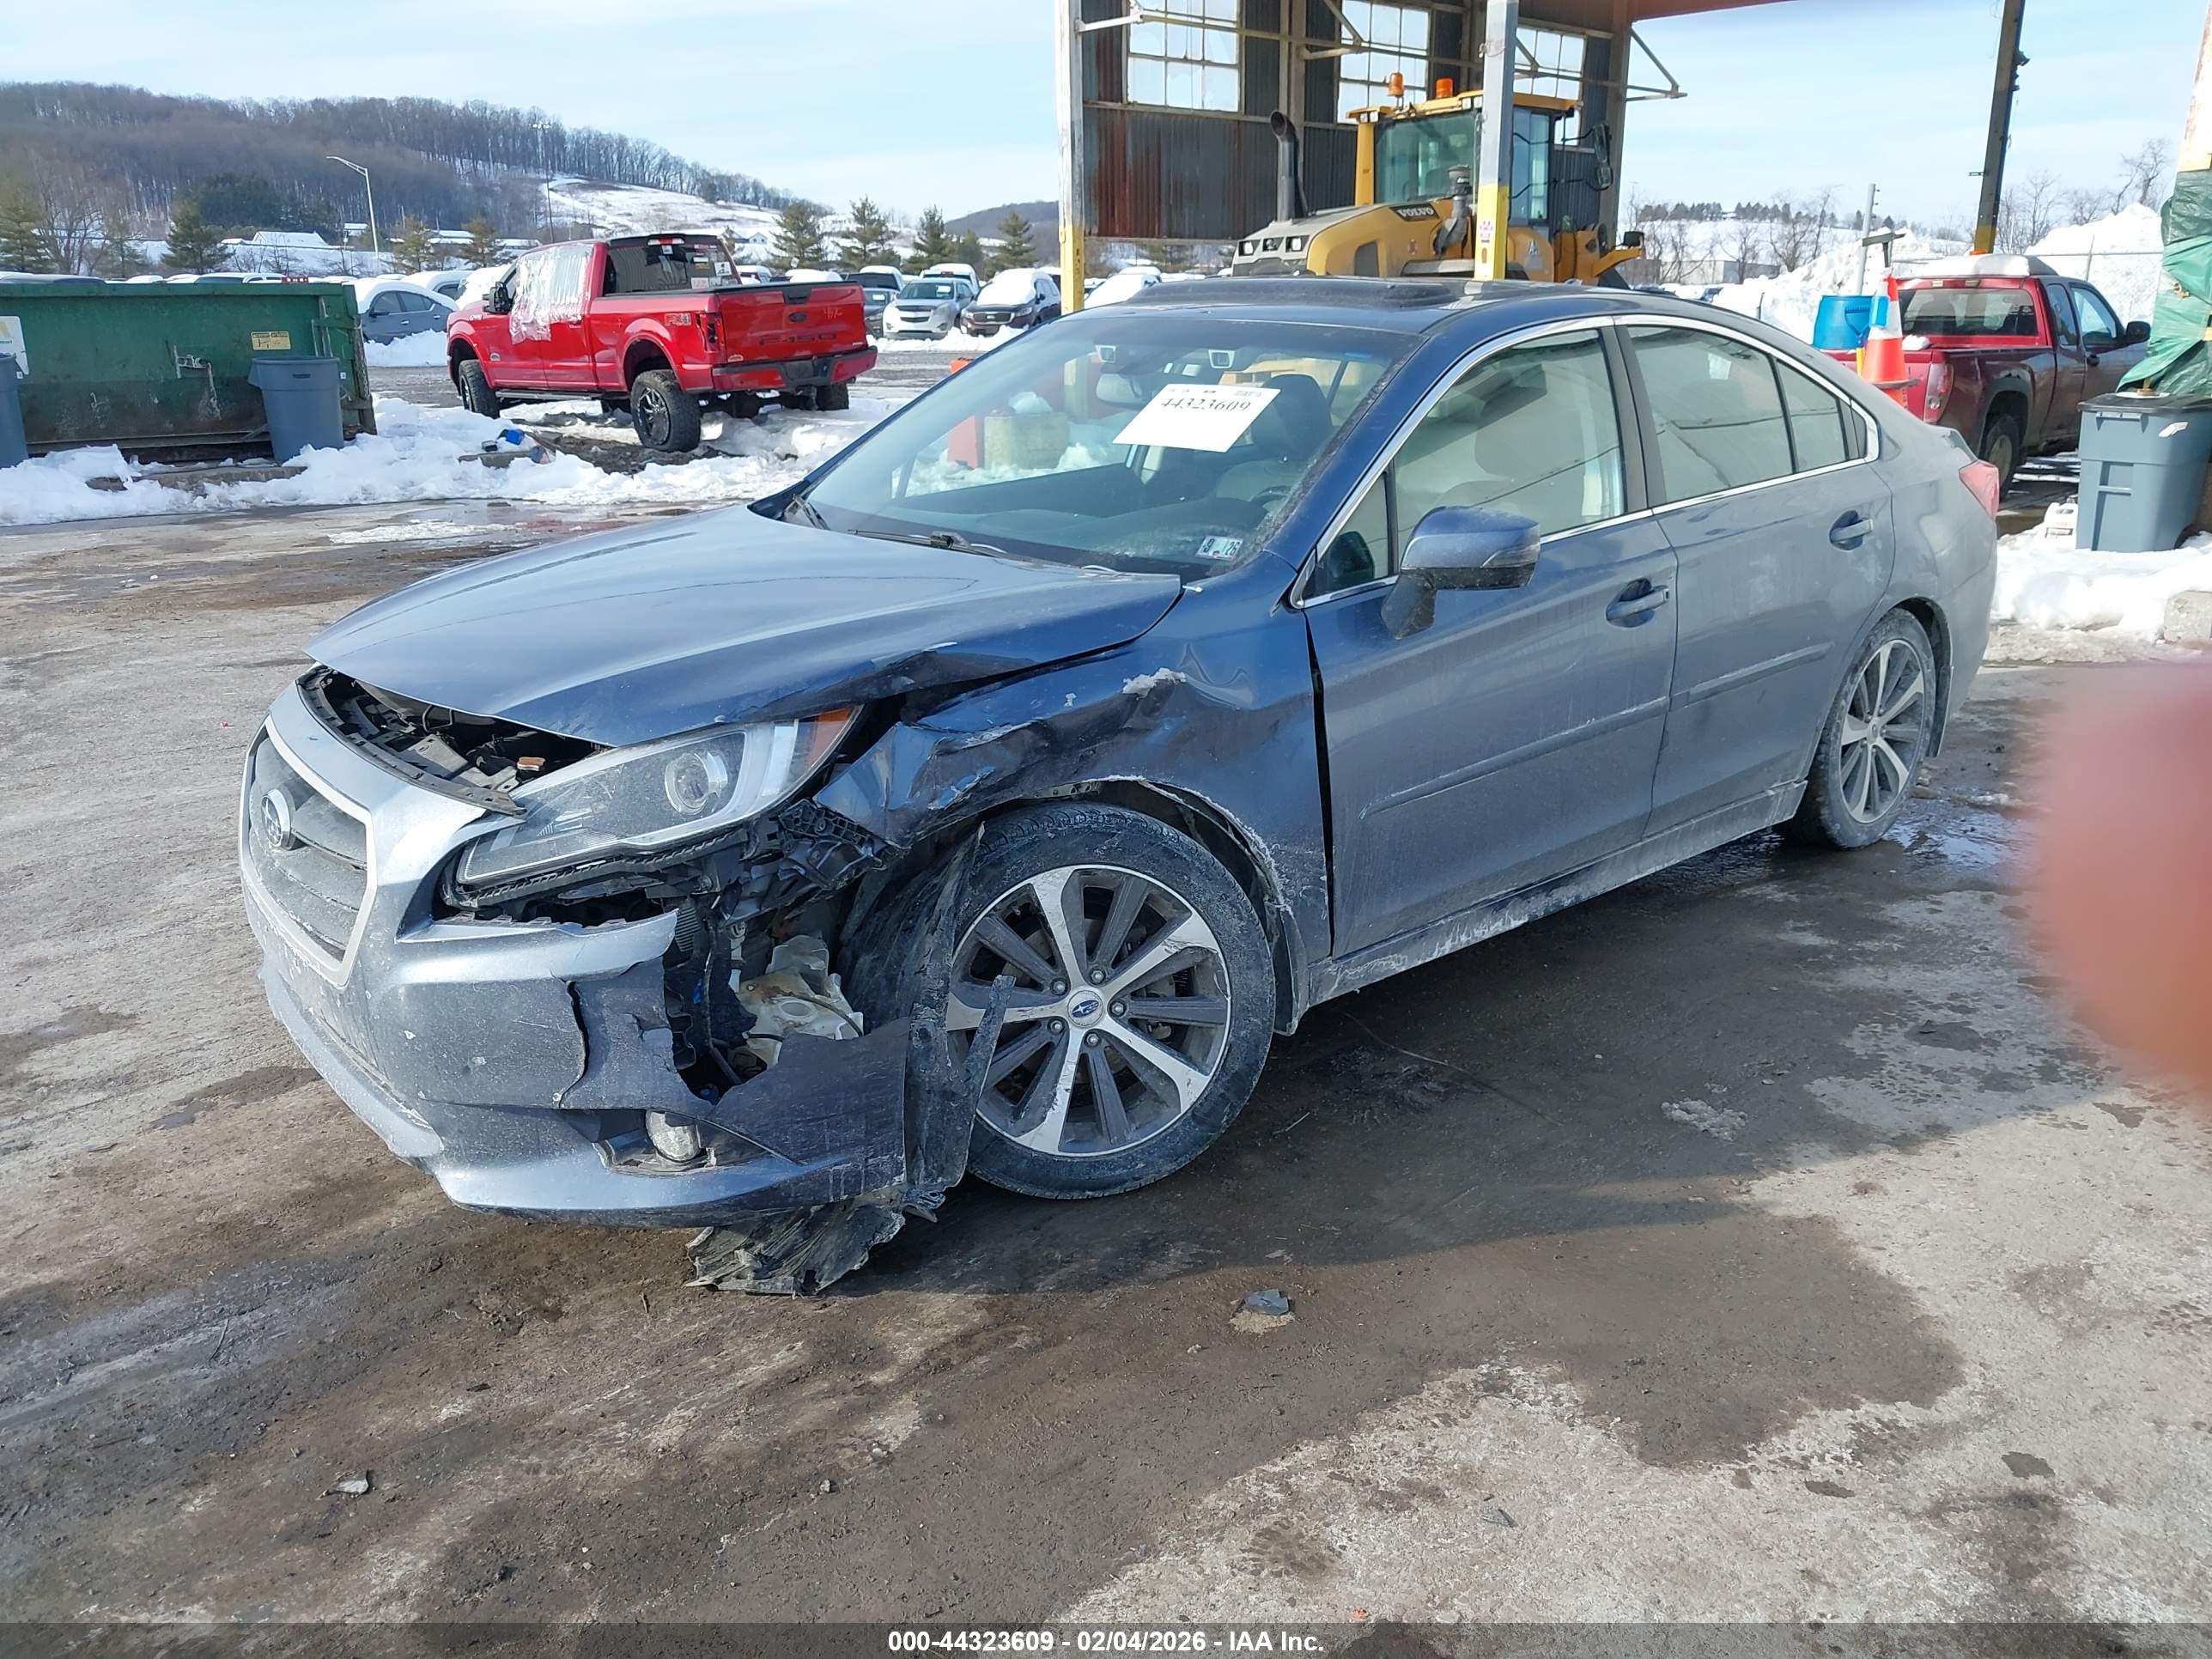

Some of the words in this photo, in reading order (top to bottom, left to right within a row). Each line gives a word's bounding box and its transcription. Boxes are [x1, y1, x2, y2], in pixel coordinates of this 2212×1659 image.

[1396, 206, 1434, 217] VOLVO
[1160, 398, 1251, 412] 44323609
[1224, 541, 1240, 556] 26
